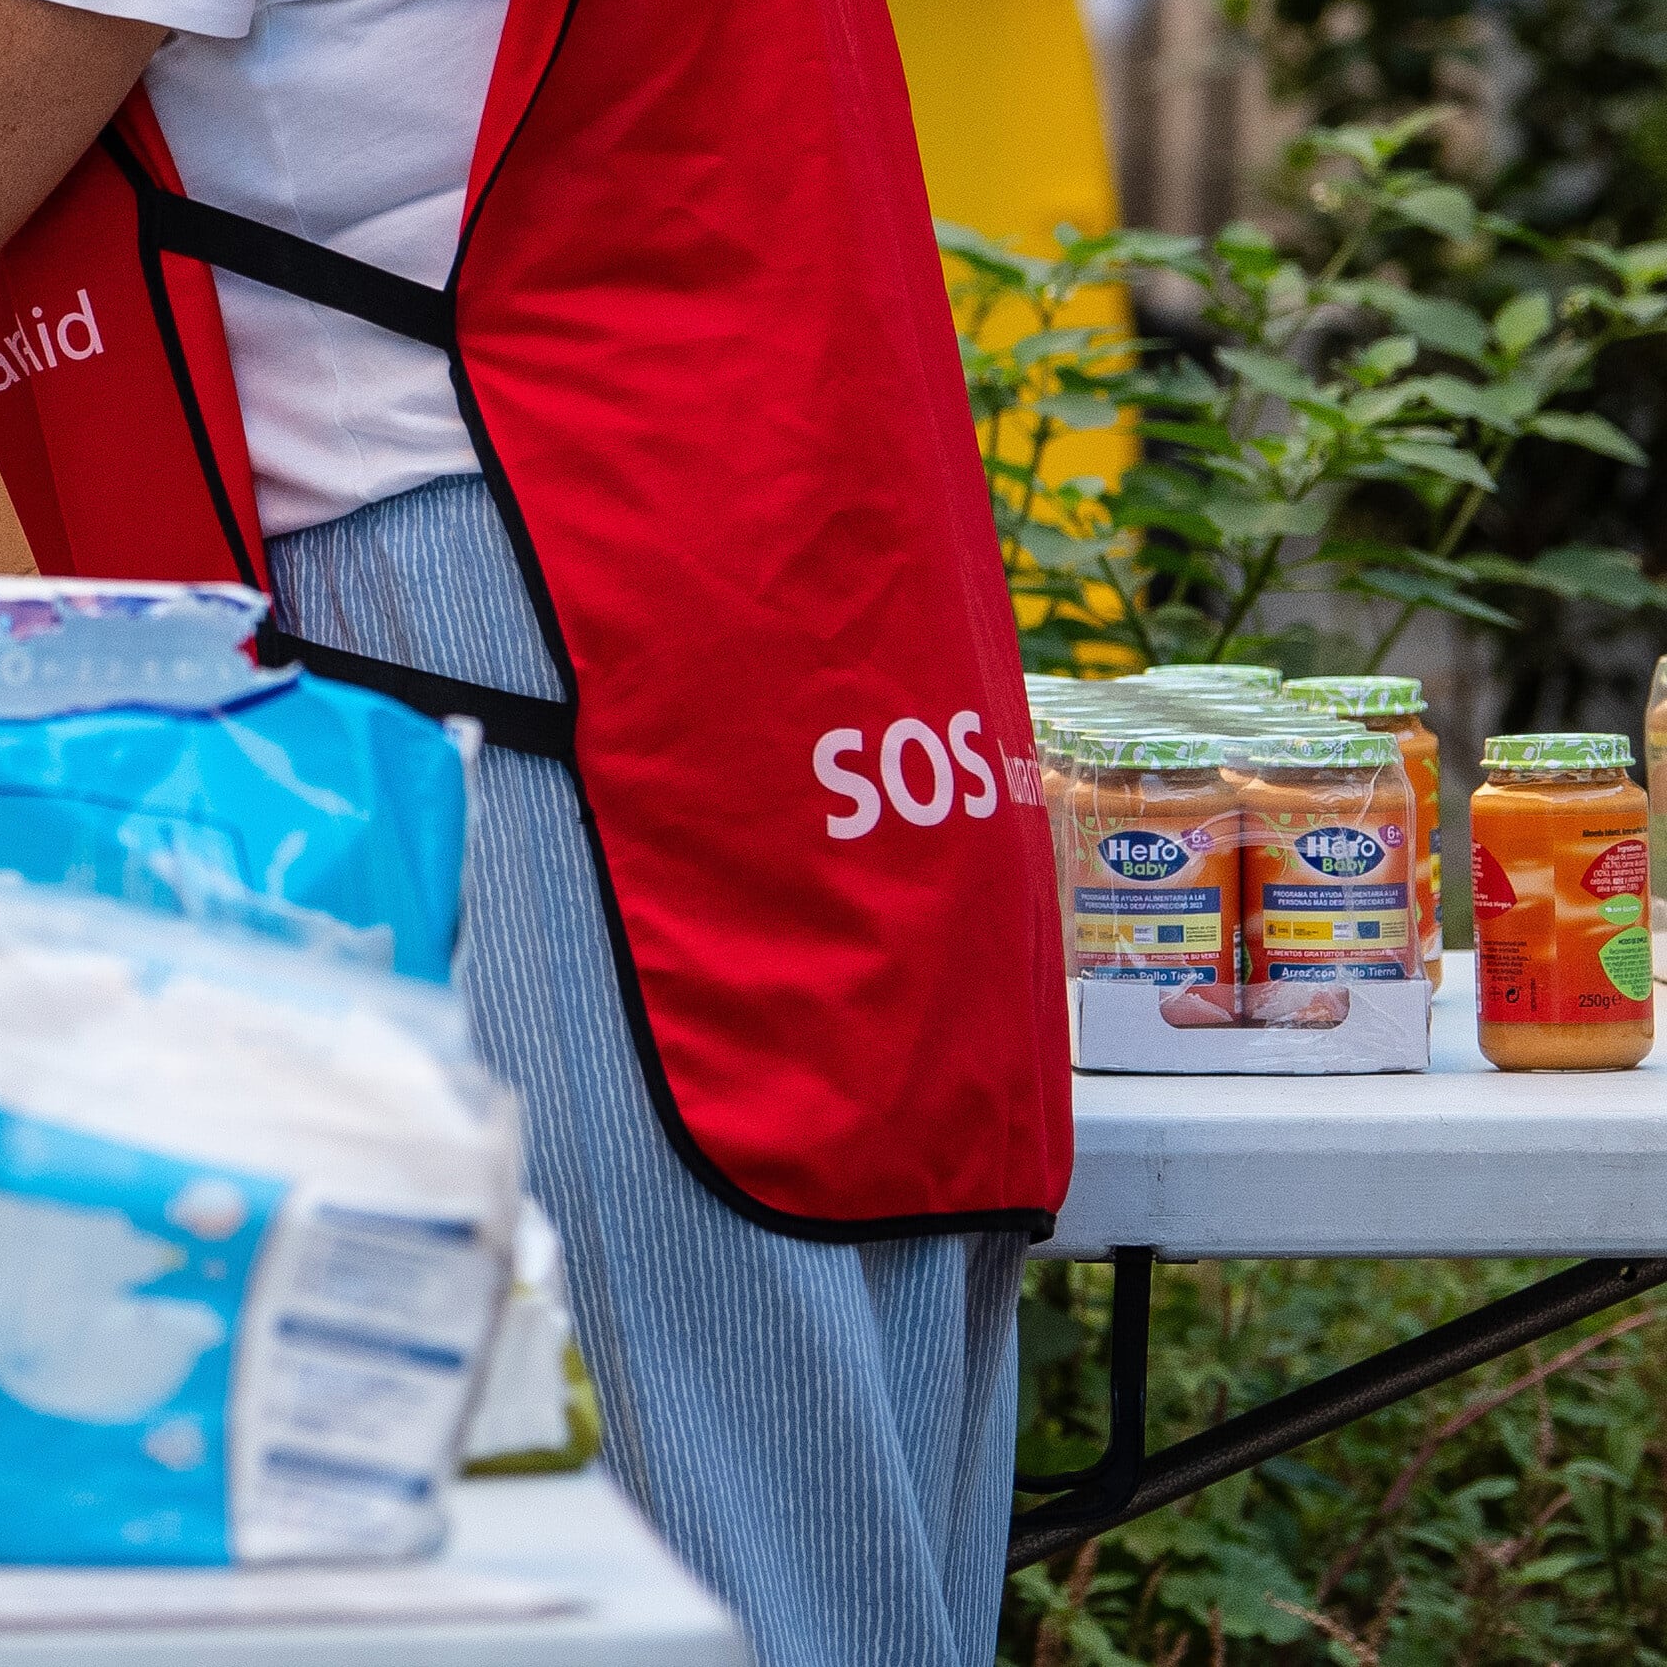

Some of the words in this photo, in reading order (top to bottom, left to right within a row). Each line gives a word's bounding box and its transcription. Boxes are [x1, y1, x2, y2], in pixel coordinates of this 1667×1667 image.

[813, 710, 998, 840] SOS
[1107, 839, 1178, 862] Hero
[1306, 835, 1377, 858] Hero
[1123, 861, 1169, 878] Baby
[1322, 858, 1367, 873] Baby
[1282, 968, 1312, 977] Arroz
[1314, 969, 1335, 977] con
